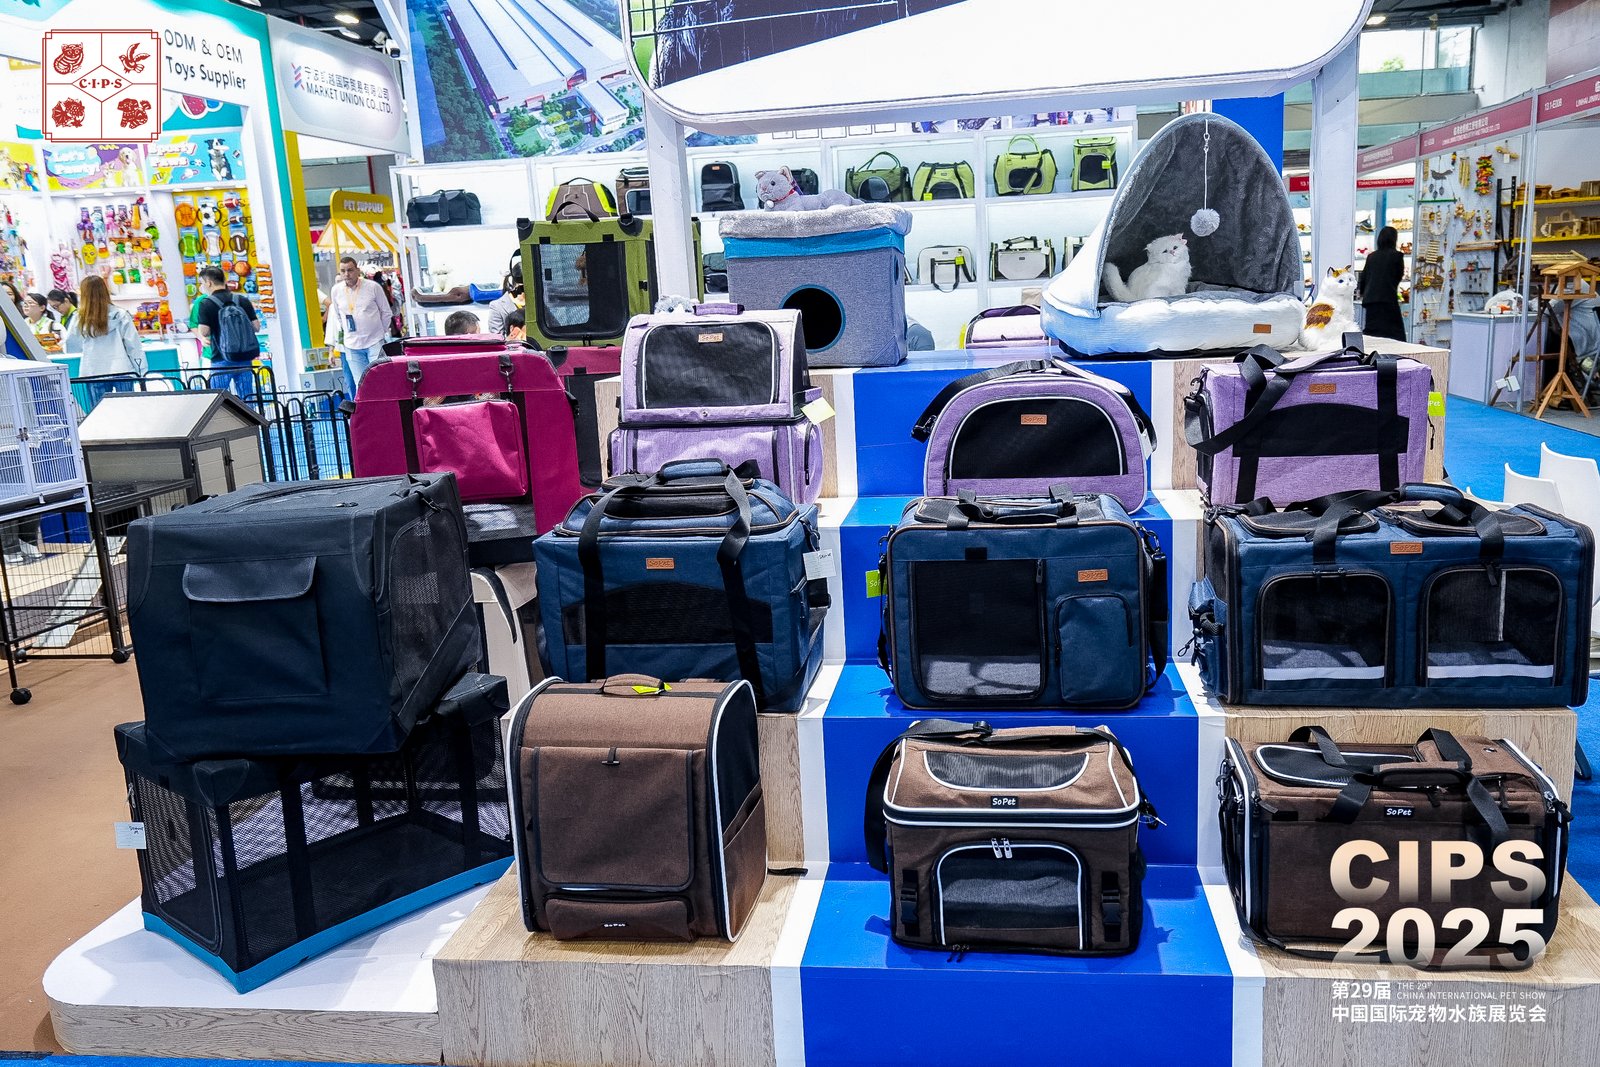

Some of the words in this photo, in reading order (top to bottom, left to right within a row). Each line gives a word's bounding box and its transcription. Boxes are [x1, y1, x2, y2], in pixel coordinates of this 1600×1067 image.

[164, 29, 196, 52] ODM
[201, 39, 212, 56] &
[216, 43, 243, 64] OEM
[165, 55, 196, 81] Toys
[199, 64, 247, 90] Supplier
[306, 82, 338, 101] MARKET
[339, 90, 365, 108] UNION
[344, 199, 355, 212] PET
